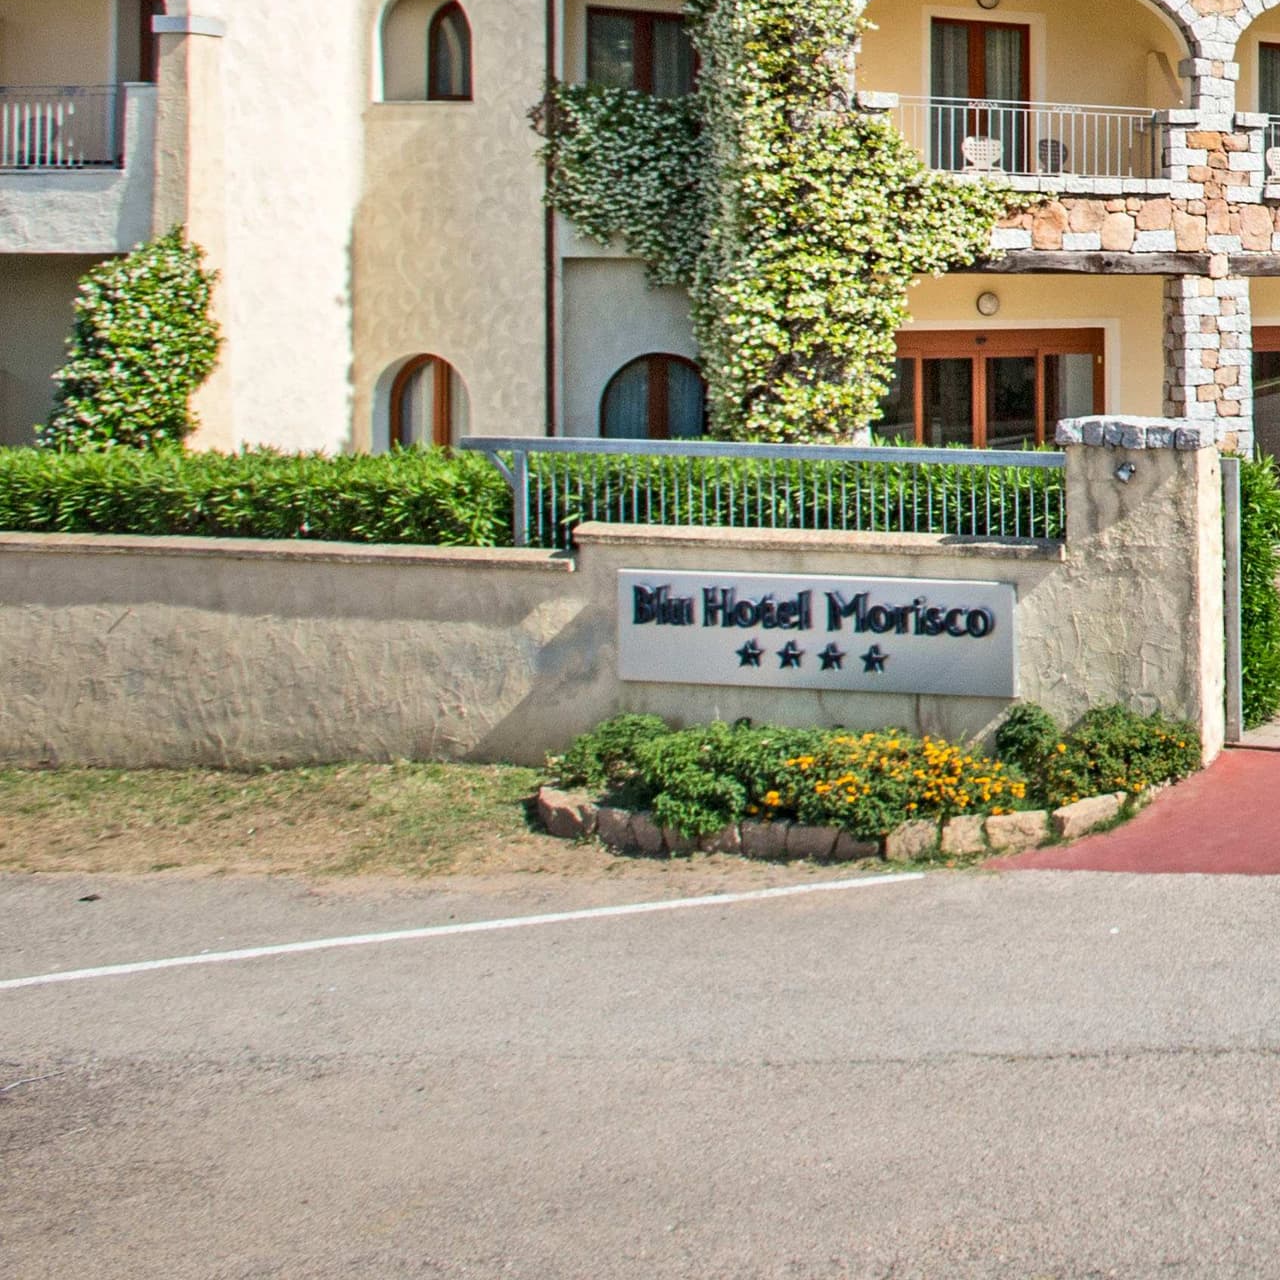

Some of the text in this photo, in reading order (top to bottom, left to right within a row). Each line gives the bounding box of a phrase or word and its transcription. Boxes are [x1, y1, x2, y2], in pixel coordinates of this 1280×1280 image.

[633, 583, 996, 638] Blu Hotel Morisco
